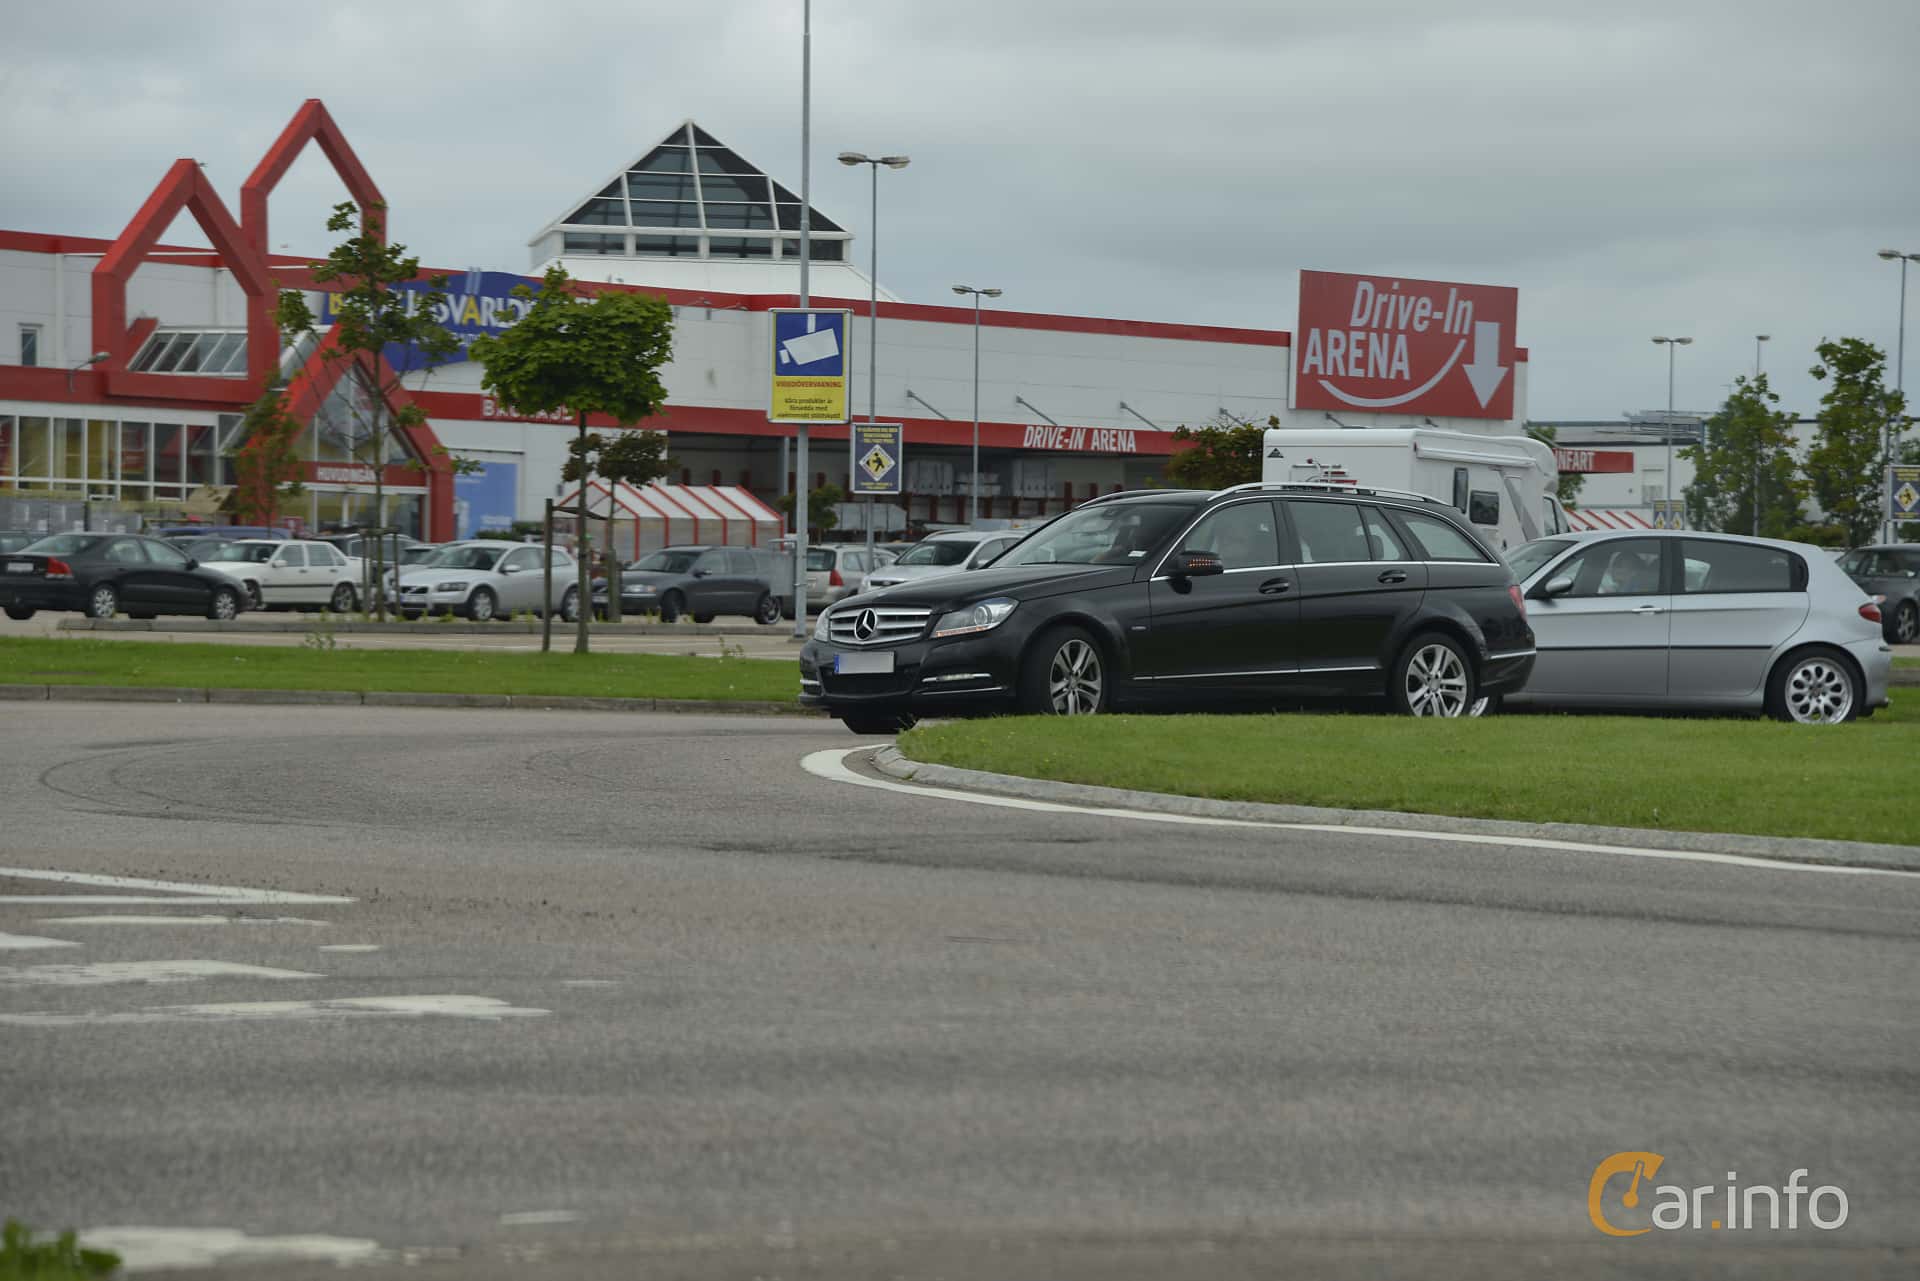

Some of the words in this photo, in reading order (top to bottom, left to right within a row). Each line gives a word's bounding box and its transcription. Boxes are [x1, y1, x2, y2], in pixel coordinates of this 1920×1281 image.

[1350, 280, 1473, 335] Drive-In
[1302, 328, 1411, 380] ARENA
[1023, 425, 1087, 451] DRIVE-IN
[1091, 429, 1137, 453] ARENA
